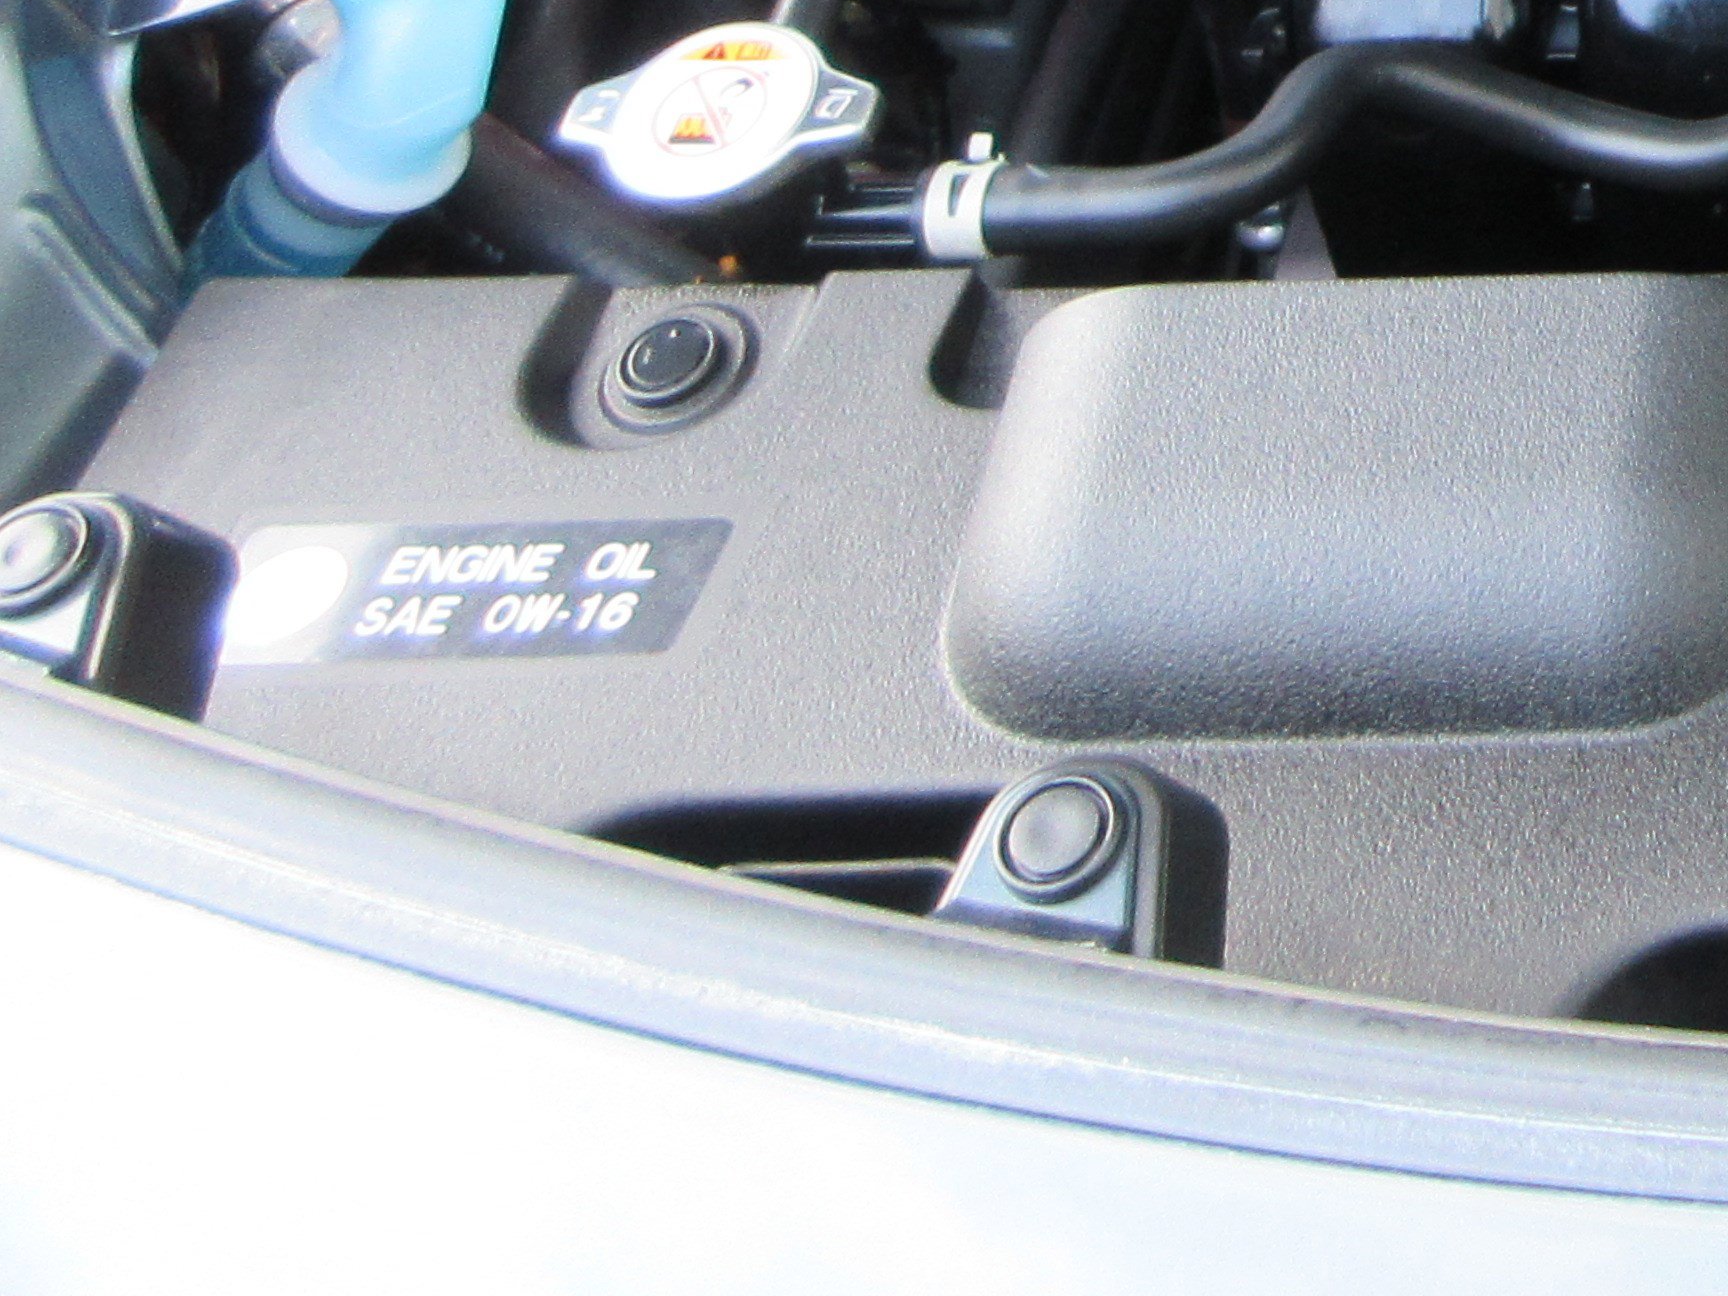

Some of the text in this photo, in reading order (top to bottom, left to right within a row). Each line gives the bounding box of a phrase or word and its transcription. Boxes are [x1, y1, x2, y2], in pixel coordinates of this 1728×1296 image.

[378, 541, 658, 586] ENGINE OIL
[351, 591, 641, 638] SAE 0W-16
